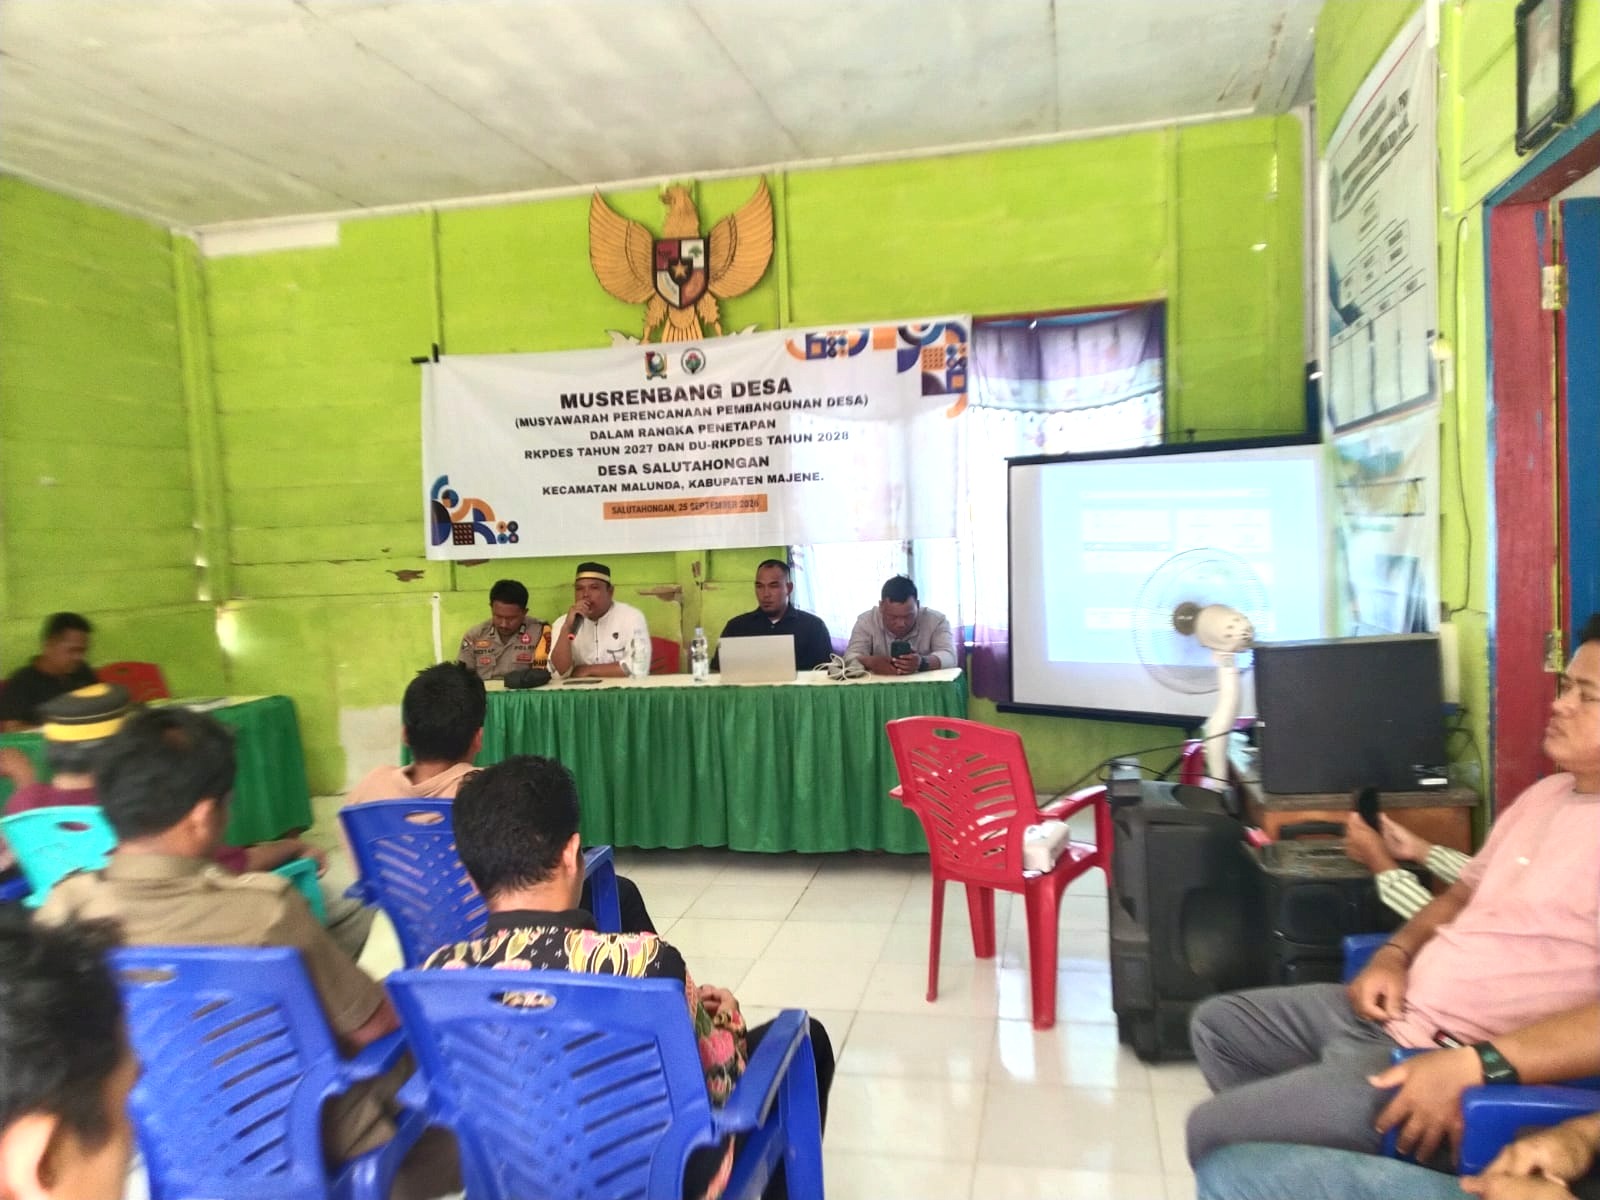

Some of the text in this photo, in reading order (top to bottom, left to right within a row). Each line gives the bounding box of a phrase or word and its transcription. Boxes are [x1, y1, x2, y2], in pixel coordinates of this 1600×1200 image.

[560, 377, 792, 410] MUSRENBANG DESA
[515, 394, 869, 429] (MUSYAWARAH PERENCANAAN PEMBANGUNAN DESA)
[590, 419, 776, 440] DALAM RANGKA PENETAPAN
[525, 431, 849, 459] RKPDES TAHUN 2027 DAN DU-RKPDES TAHUN 2028
[598, 456, 769, 476] DESA SALUTAHONGAN
[542, 472, 824, 495] KECAMATAN MALUNDA, KABUPATEN MAJENE.
[612, 503, 676, 514] SALUTAHONGAN,
[679, 502, 688, 511] 25
[690, 500, 737, 511] SEPTEMBER
